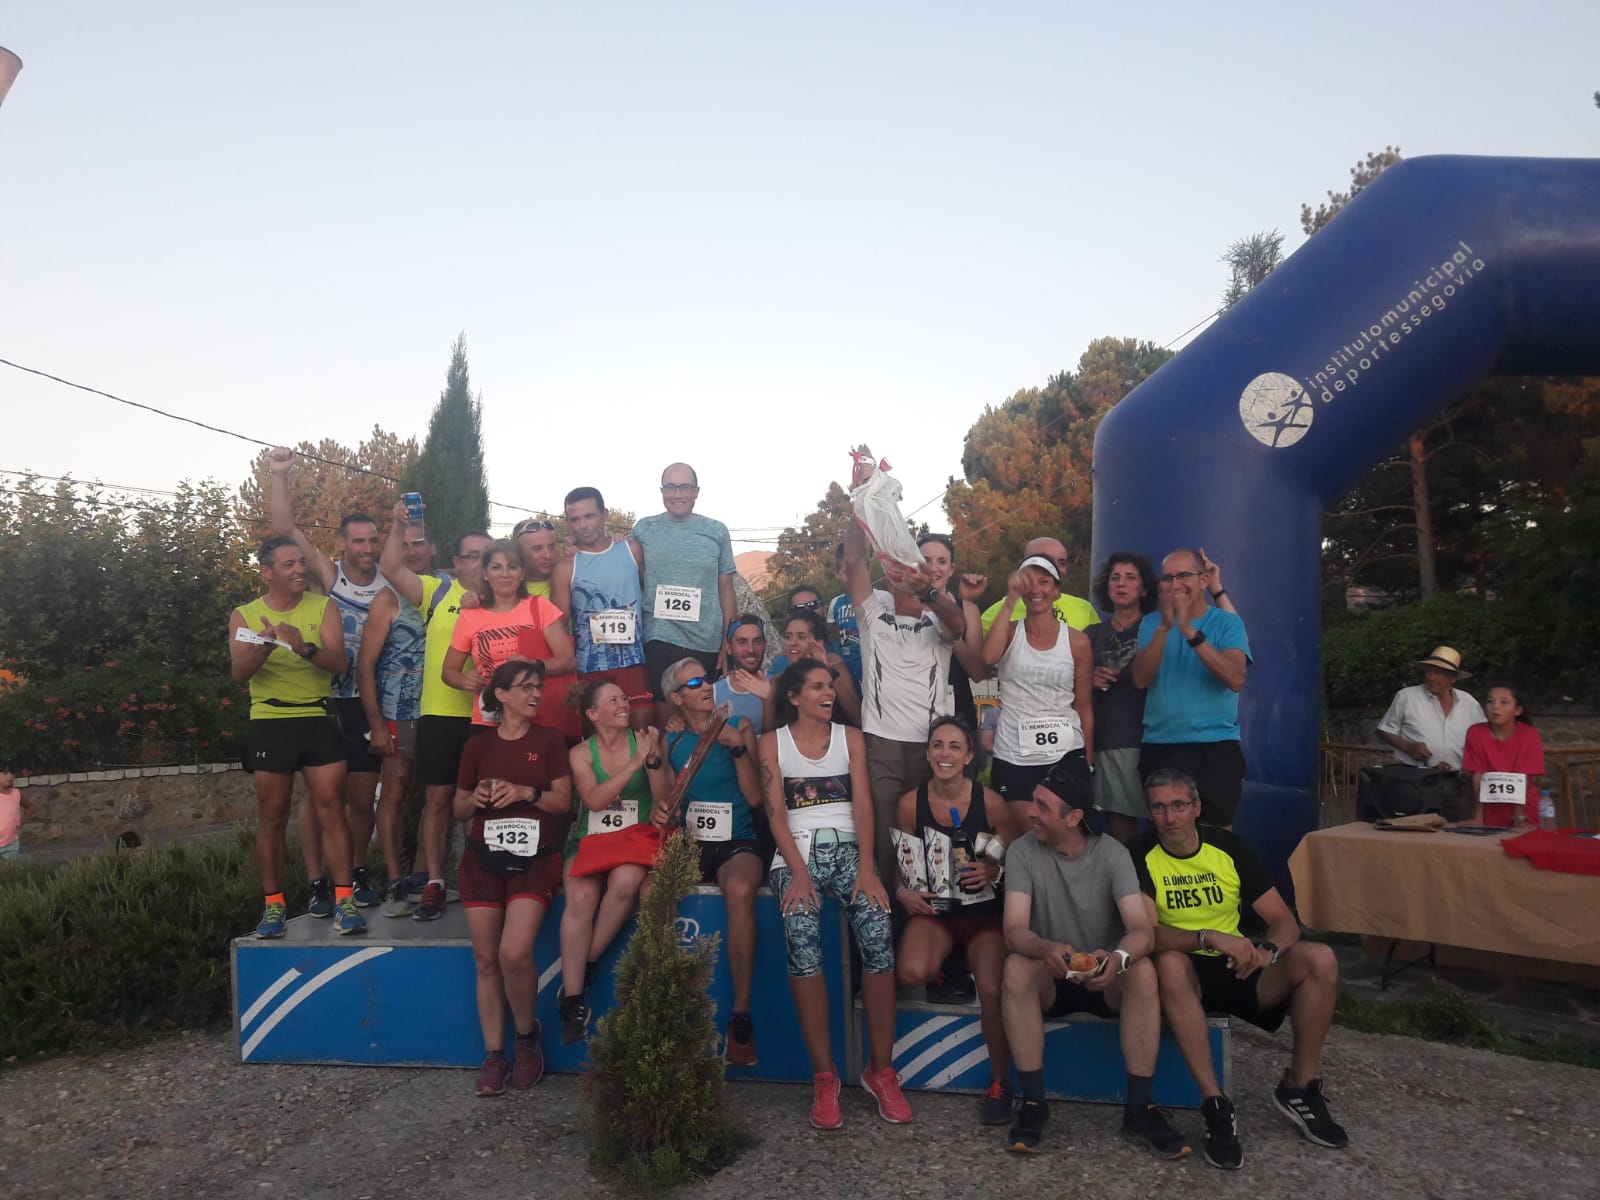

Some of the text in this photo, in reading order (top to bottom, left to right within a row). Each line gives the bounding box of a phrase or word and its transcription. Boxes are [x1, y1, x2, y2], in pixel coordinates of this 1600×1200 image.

[1305, 240, 1473, 389] institutomunicipal
[1320, 258, 1485, 403] deportessegovia
[664, 598, 691, 611] 126
[600, 622, 627, 634] 119
[1035, 731, 1058, 746] 86
[1488, 783, 1516, 794] 219
[601, 814, 623, 827] 46
[696, 815, 717, 830] 59
[496, 831, 529, 845] 132
[1162, 872, 1217, 886] EL ÚNICO LÍMITE
[1165, 883, 1224, 910] ERES TÚ
